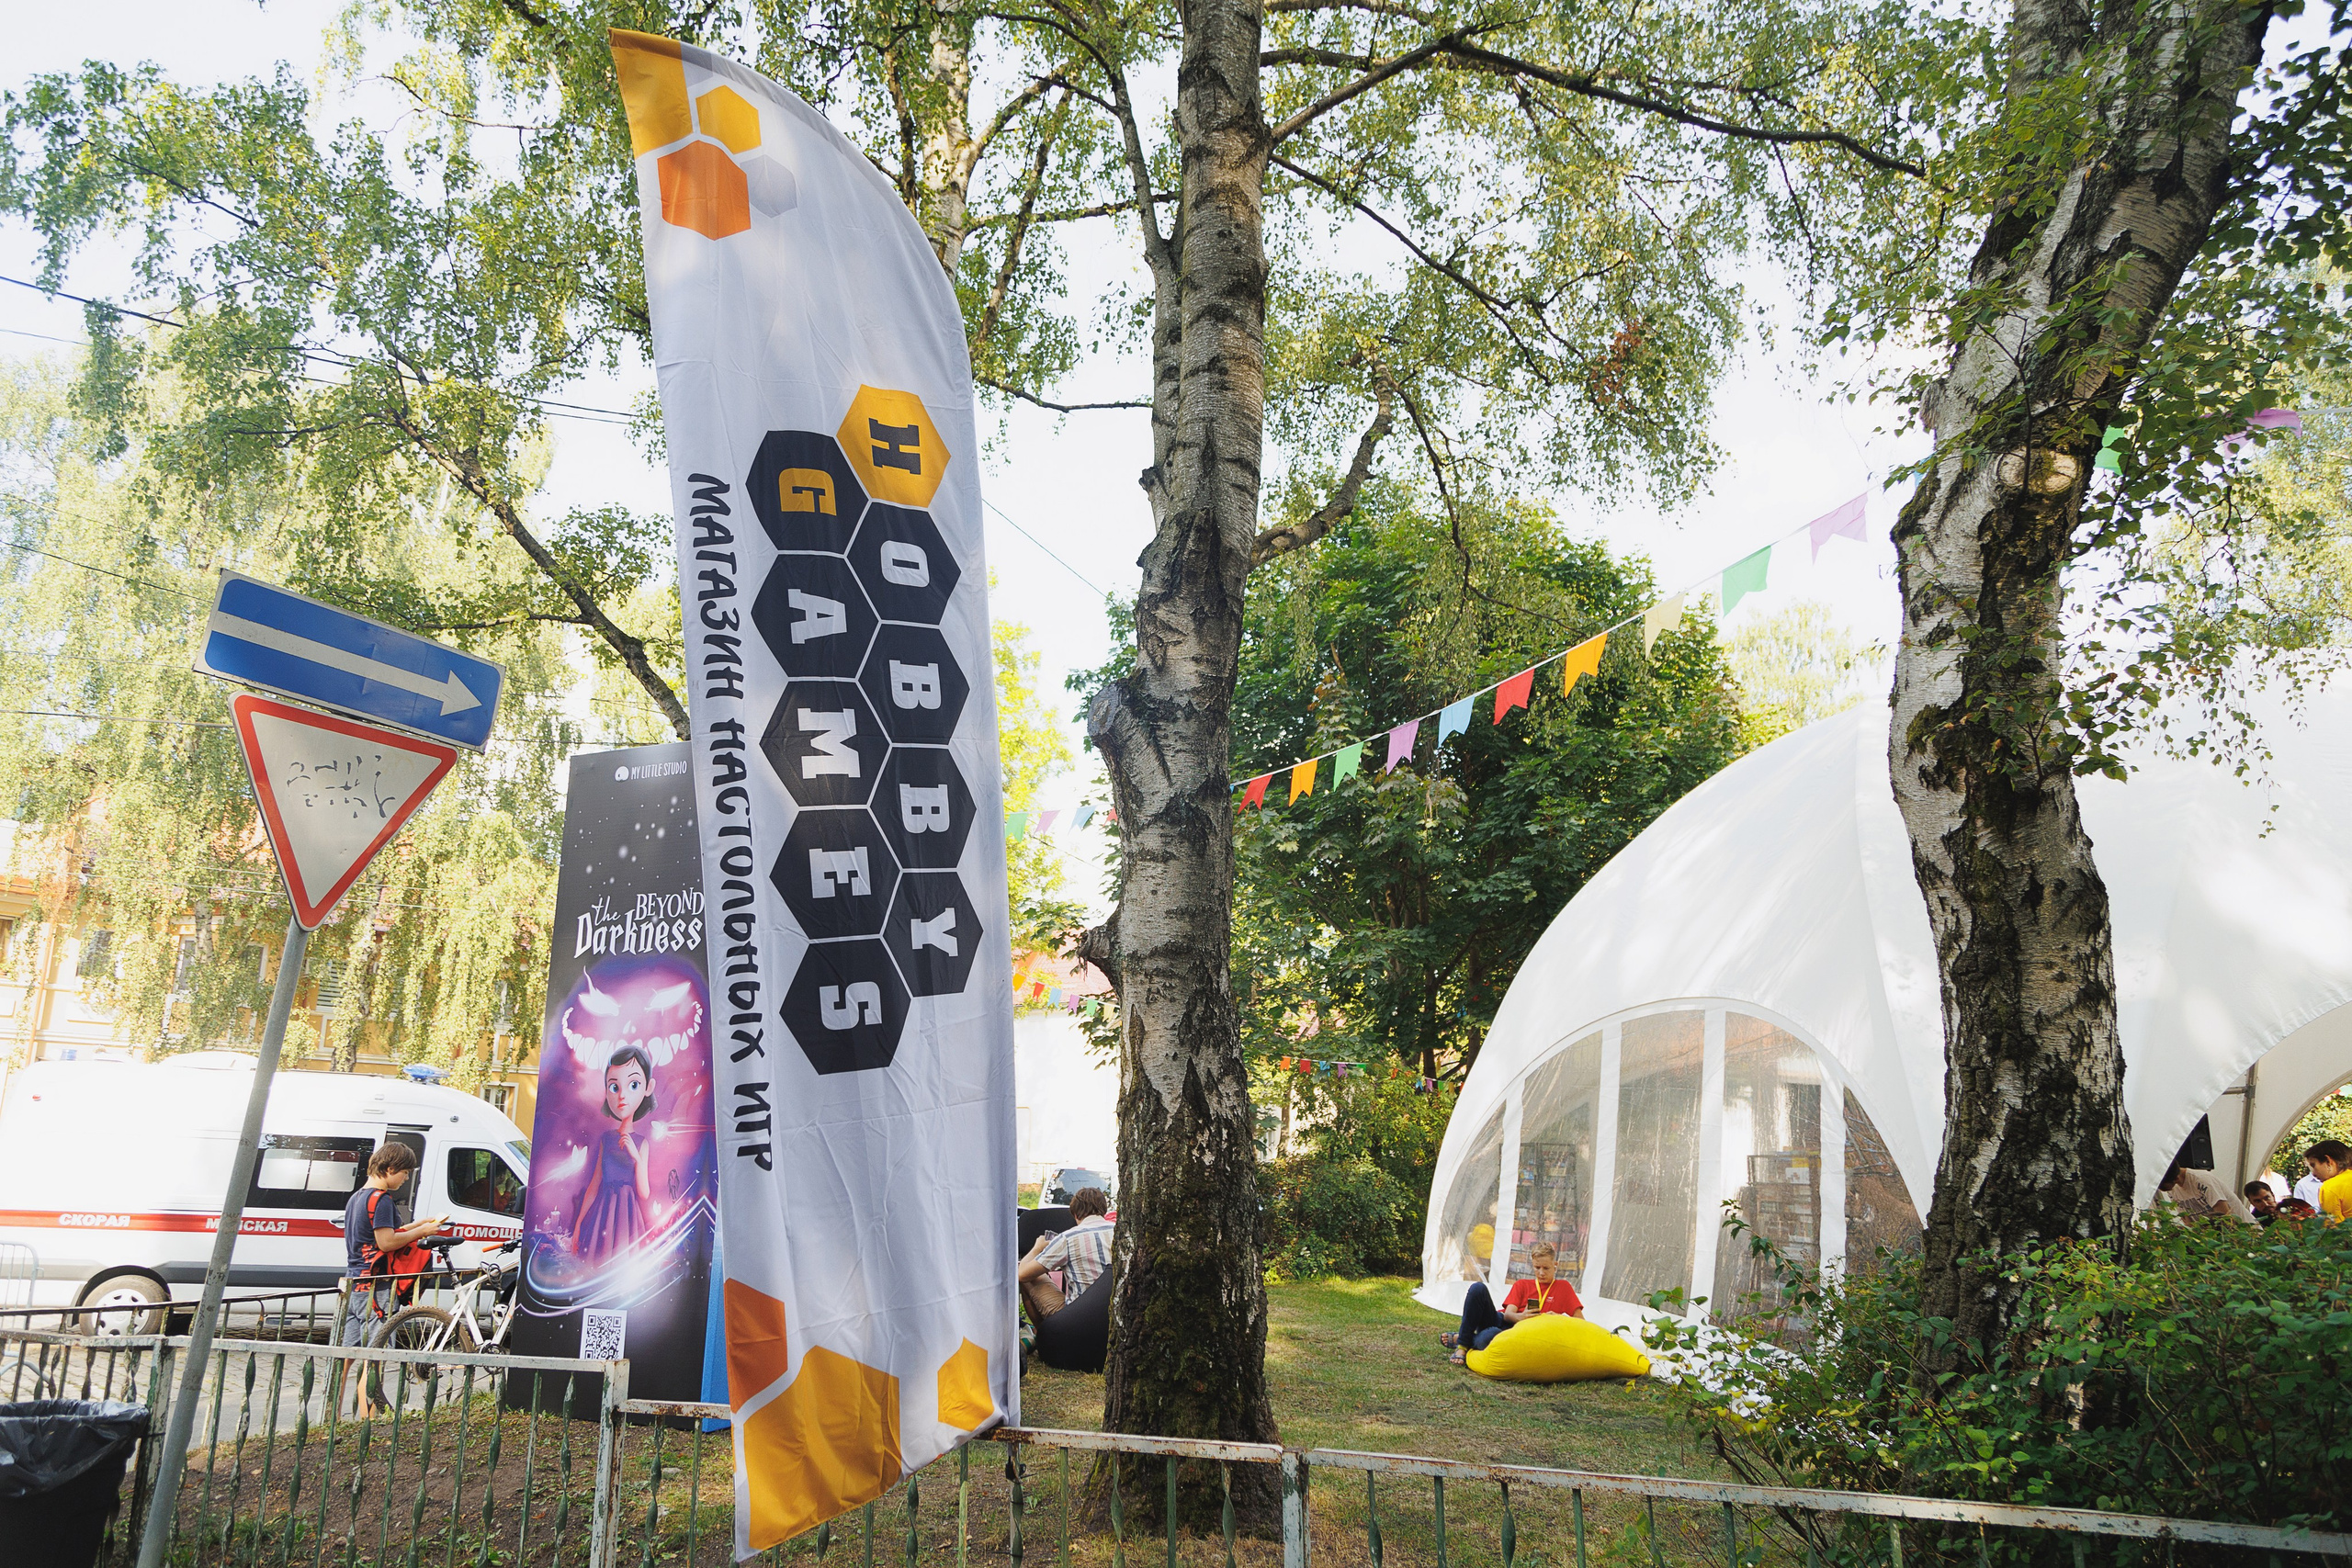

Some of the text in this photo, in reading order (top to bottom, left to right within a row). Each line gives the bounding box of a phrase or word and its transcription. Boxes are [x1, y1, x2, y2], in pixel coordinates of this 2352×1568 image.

[868, 417, 959, 958] HOBBY
[630, 760, 687, 780] MY LITTLE STUDIO
[778, 467, 883, 1031] GAMES
[686, 472, 773, 1172] МАГАЗИН НАСТОЛЬНЫХ ИГР
[591, 886, 706, 927] the BEYOND
[573, 909, 704, 959] Darkness
[58, 1213, 131, 1228] СКОРАЯ
[452, 1225, 524, 1240] ПОМОЩЬ
